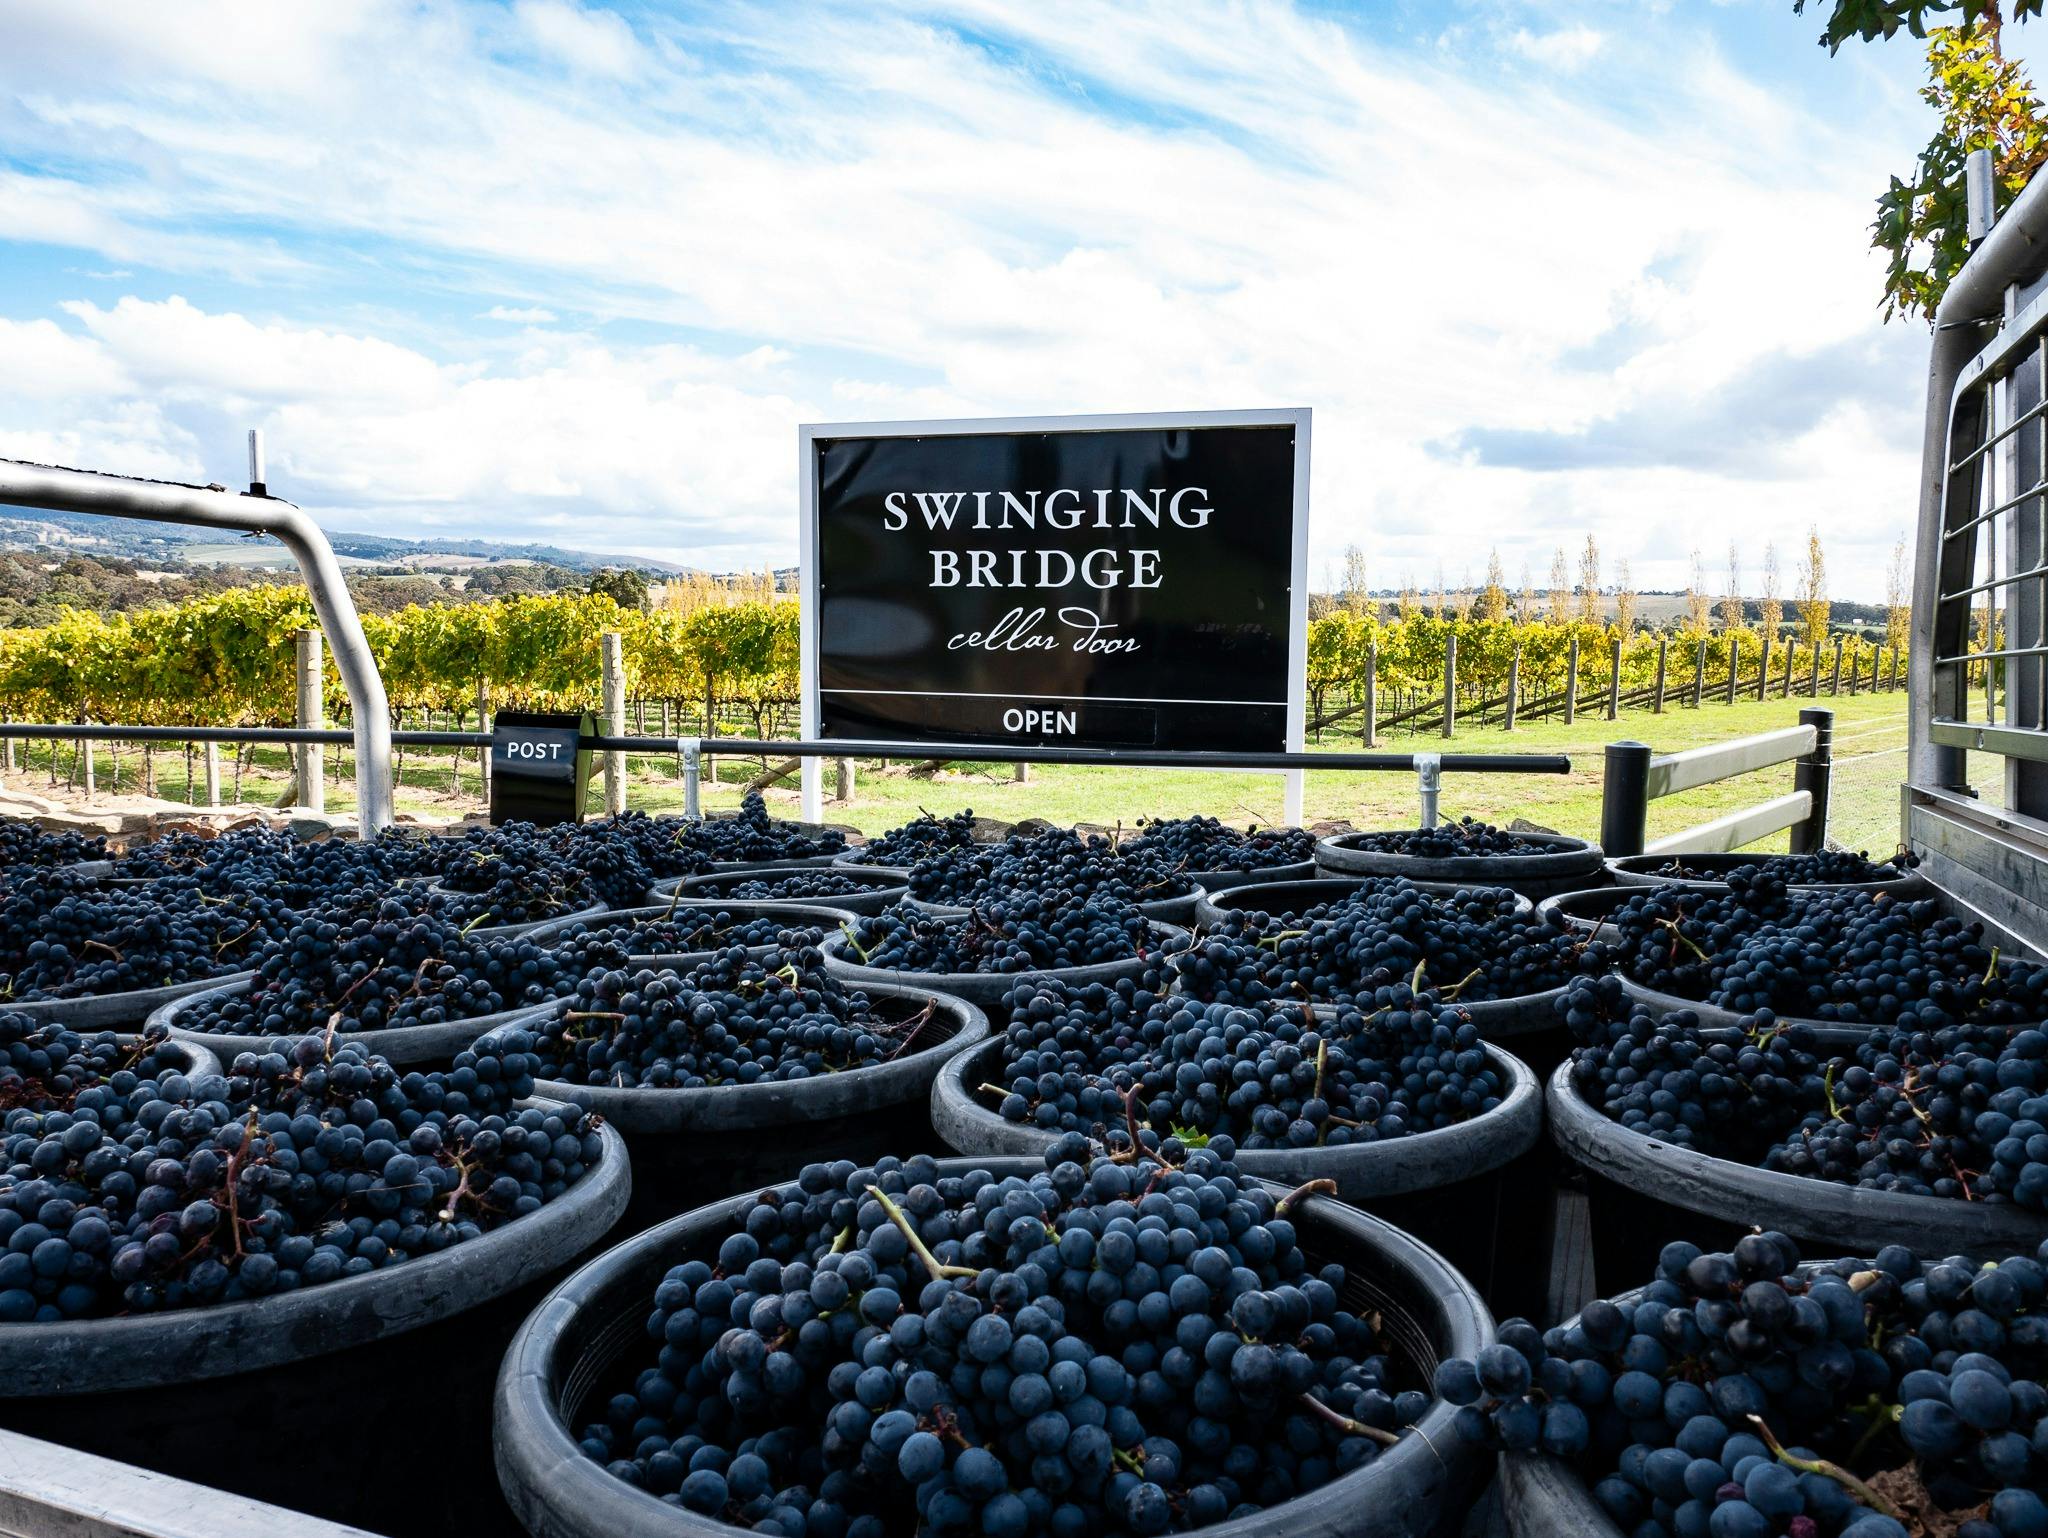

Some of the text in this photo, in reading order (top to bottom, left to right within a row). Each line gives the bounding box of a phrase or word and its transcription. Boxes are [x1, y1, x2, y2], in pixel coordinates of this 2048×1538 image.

[884, 487, 1215, 531] SWINGING
[928, 548, 1164, 589] BRIDGE
[947, 606, 1141, 654] cellar door
[1002, 708, 1077, 735] OPEN
[507, 741, 562, 760] POST
